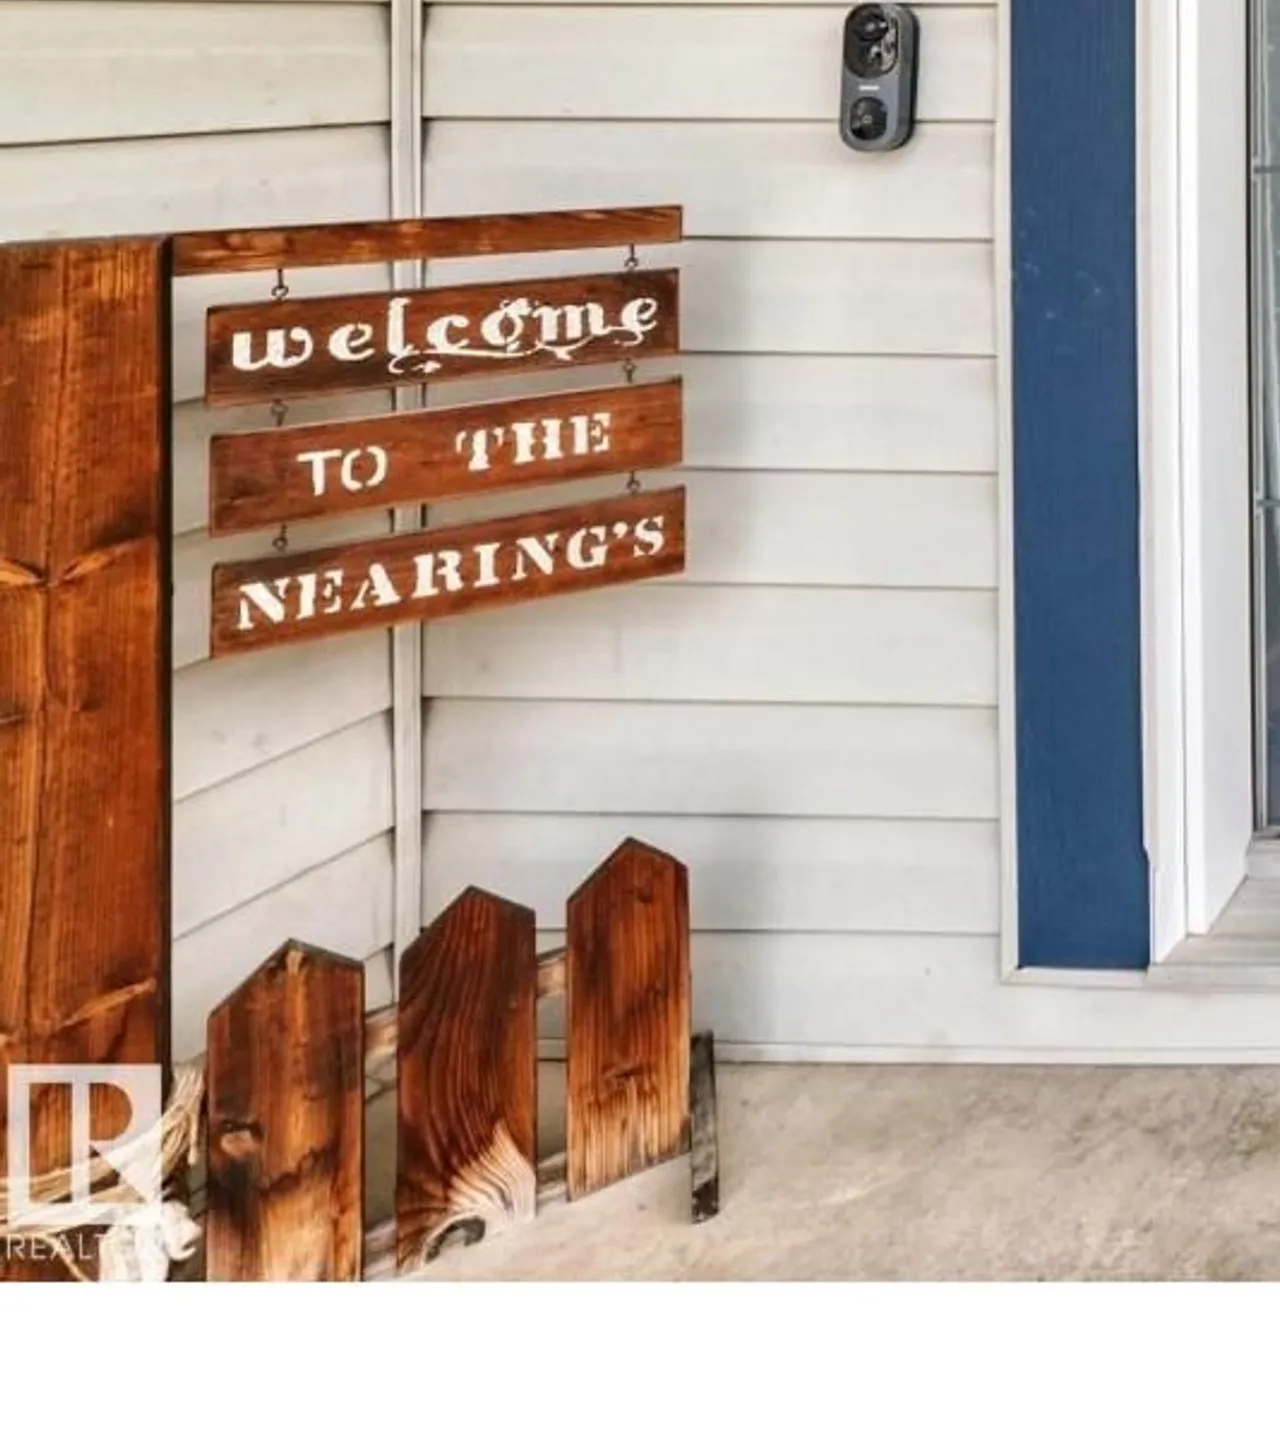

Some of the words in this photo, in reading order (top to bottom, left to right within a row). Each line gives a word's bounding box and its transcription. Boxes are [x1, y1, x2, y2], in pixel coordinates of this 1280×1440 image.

[231, 296, 658, 374] welcome
[296, 445, 388, 497] TO
[454, 411, 612, 472] THE
[236, 515, 665, 631] NEARING'S
